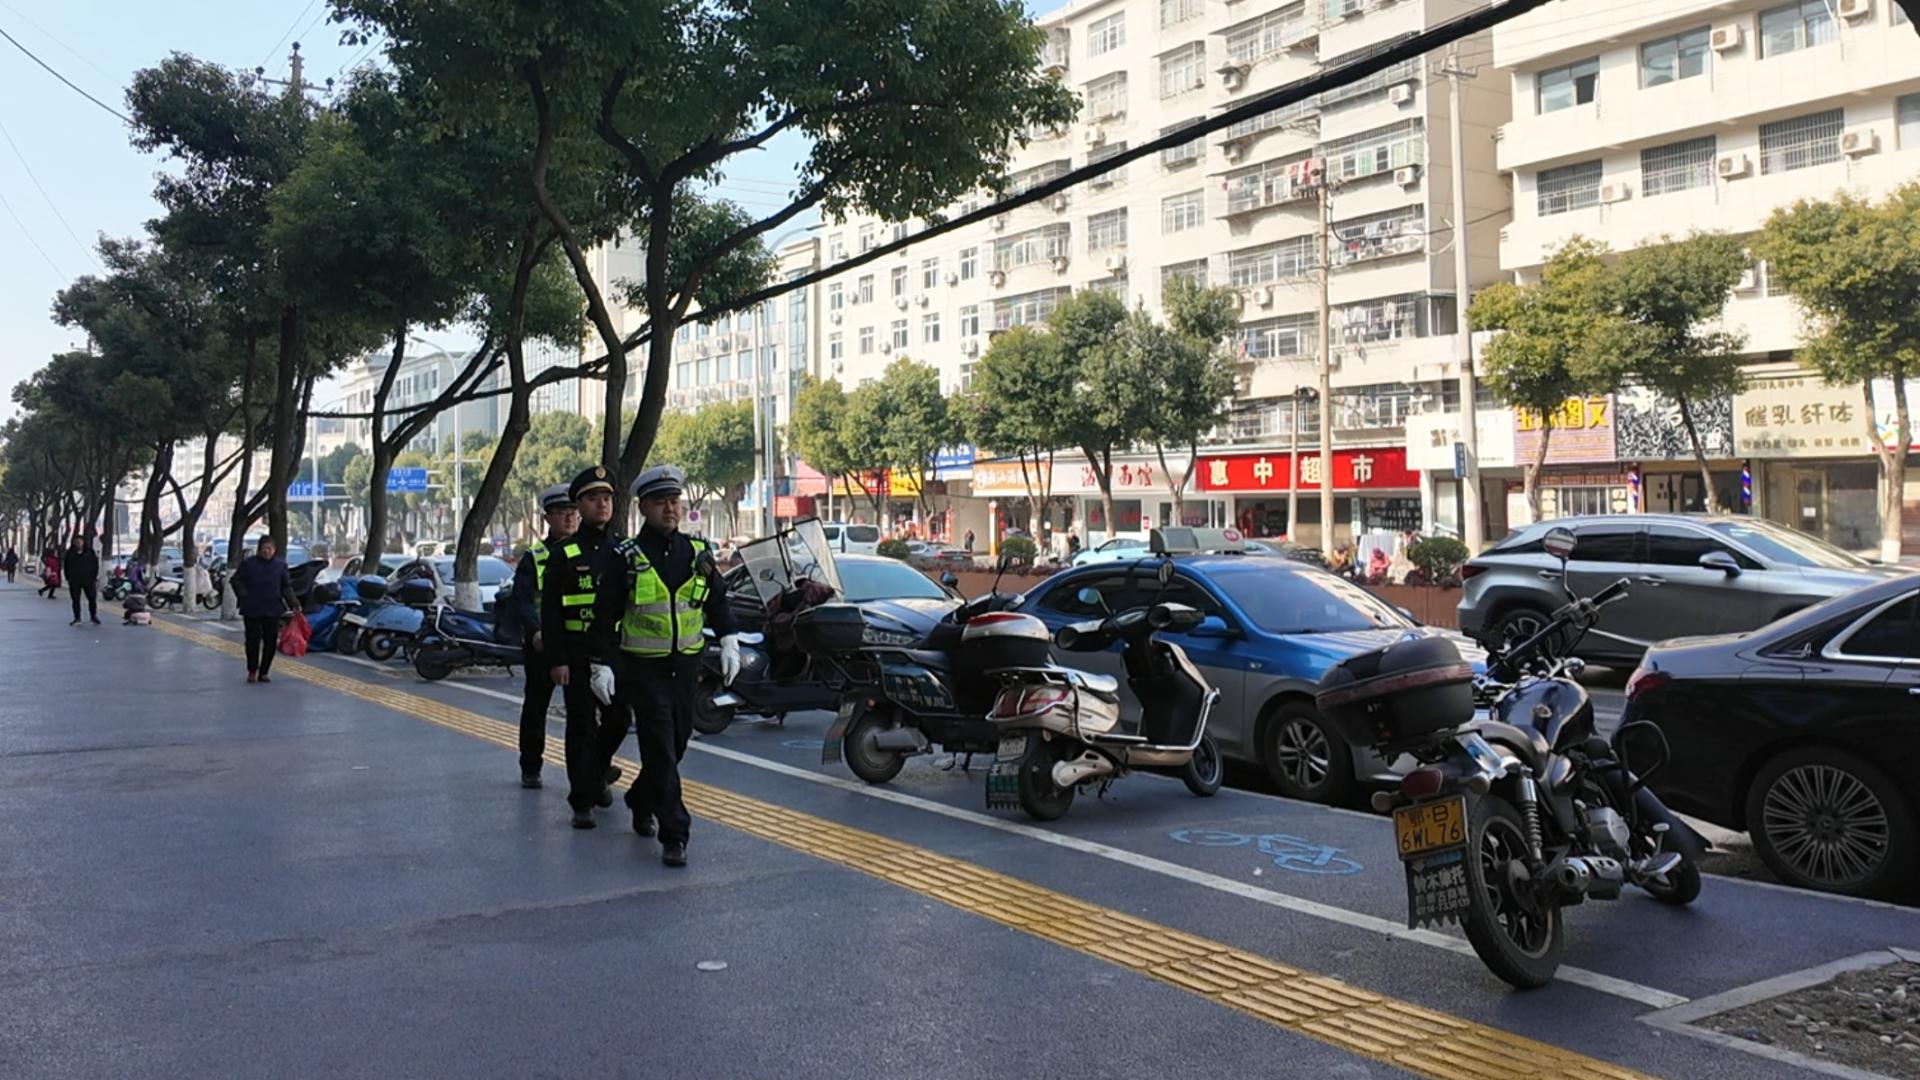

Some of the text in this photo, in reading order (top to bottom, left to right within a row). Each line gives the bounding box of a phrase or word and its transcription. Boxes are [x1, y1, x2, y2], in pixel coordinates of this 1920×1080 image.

[1745, 400, 1854, 428] 催乳纤体
[1208, 453, 1374, 487] 惠中超市
[1401, 820, 1461, 852] 6WL76
